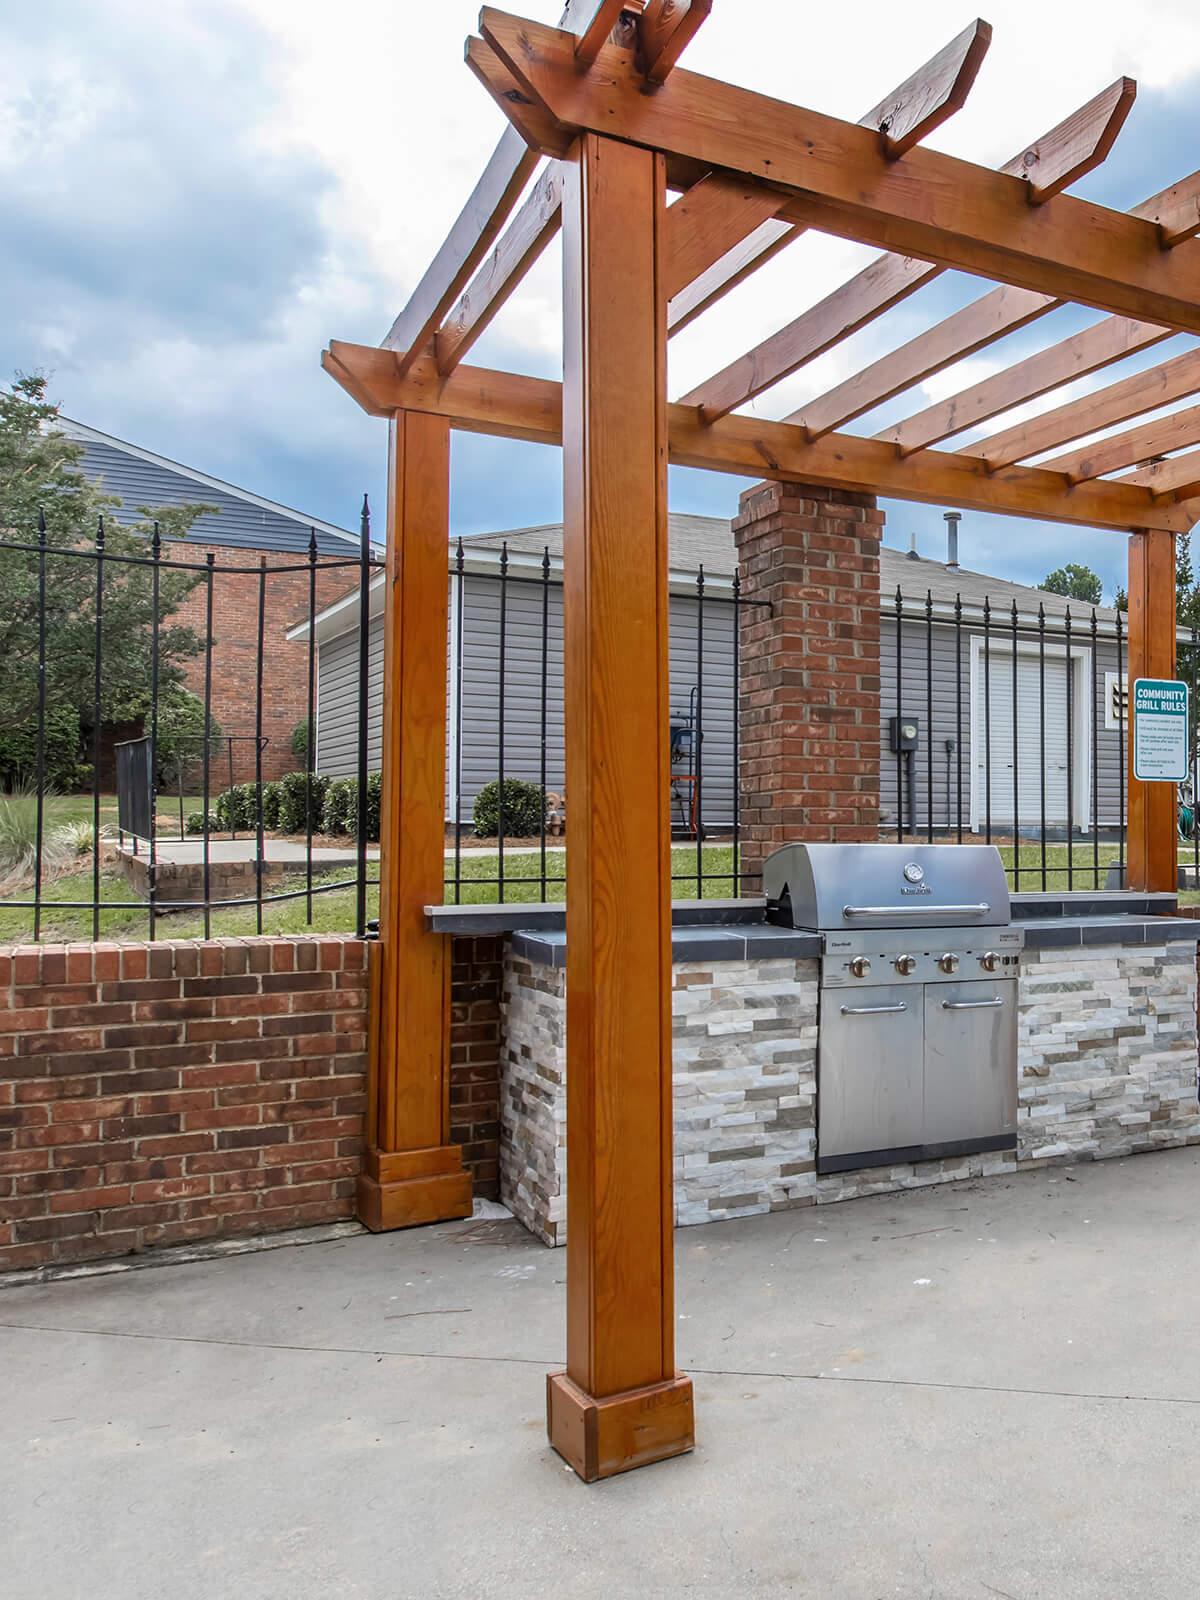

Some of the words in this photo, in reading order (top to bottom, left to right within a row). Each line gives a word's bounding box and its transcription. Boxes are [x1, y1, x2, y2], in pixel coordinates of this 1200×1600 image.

[1137, 689, 1185, 701] COMMUNITY
[1136, 699, 1160, 710] GRILL
[1161, 701, 1186, 712] RULES
